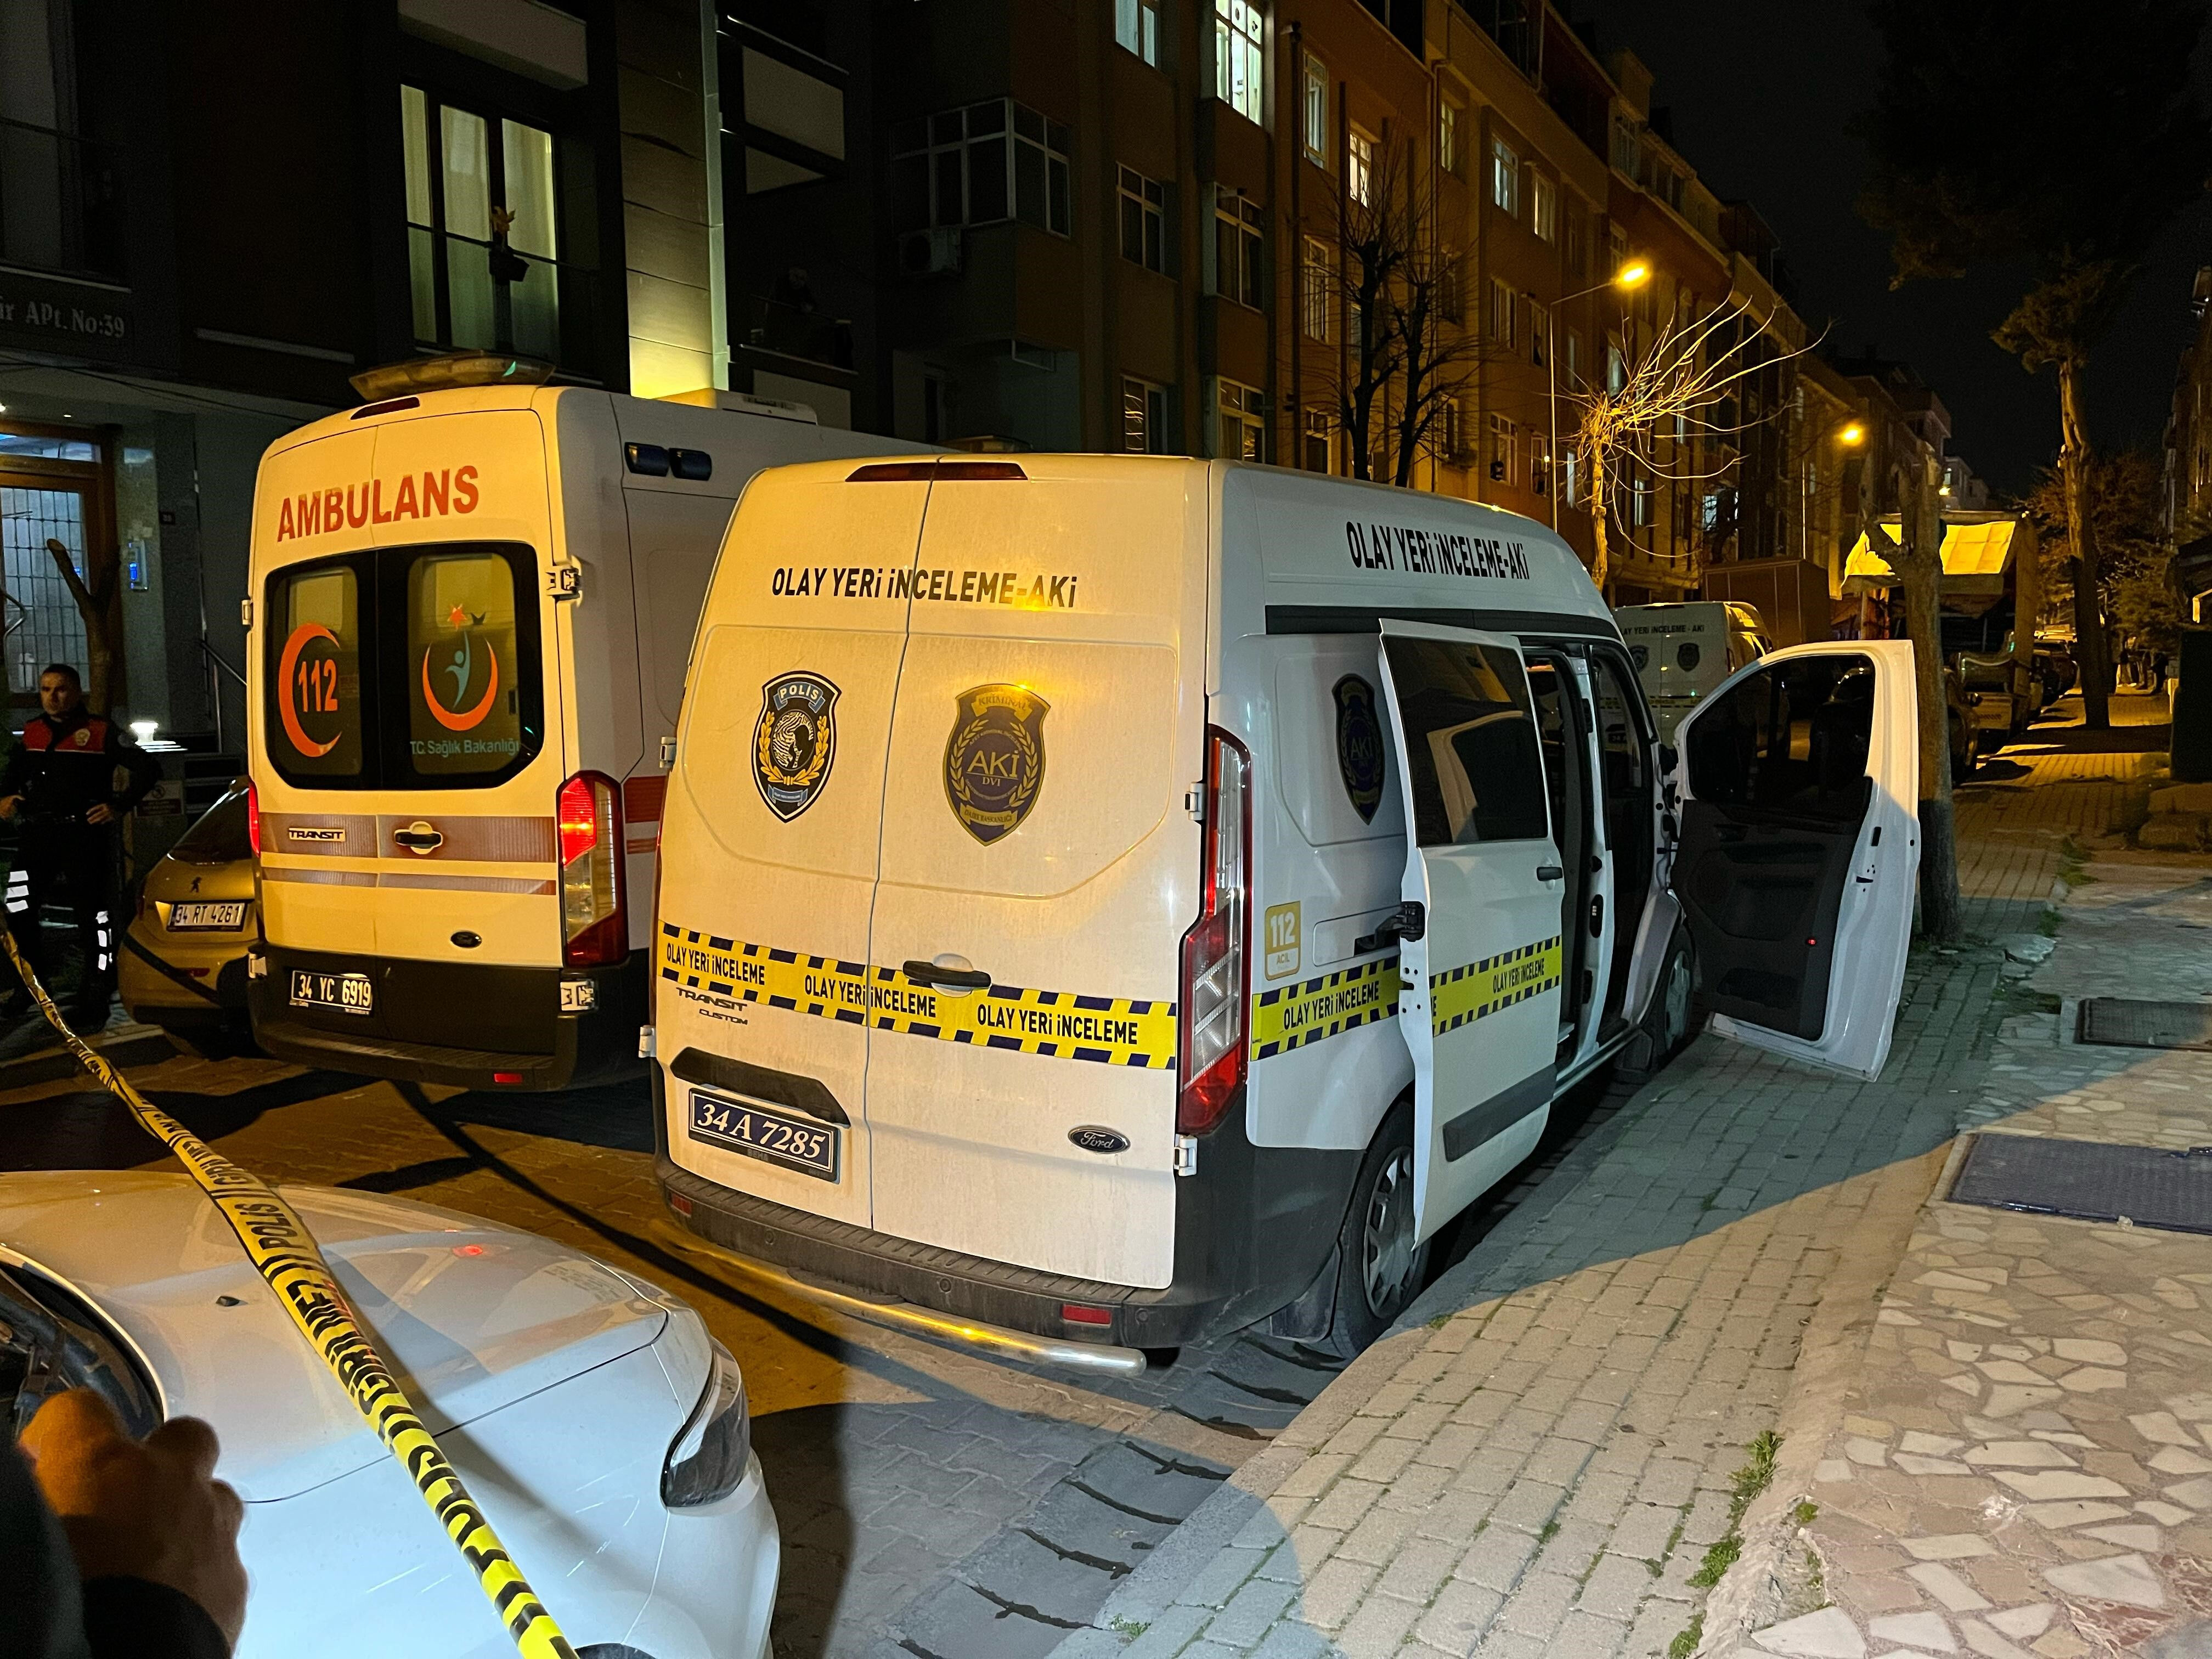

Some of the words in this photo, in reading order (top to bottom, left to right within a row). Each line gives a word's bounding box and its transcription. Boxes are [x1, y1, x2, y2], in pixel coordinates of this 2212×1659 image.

[277, 465, 479, 542] AMBULANS
[1346, 521, 1394, 571] OLAY
[772, 568, 827, 596] OLAY
[298, 659, 338, 712] 112
[289, 829, 344, 840] TRANSIT
[176, 906, 188, 923] 34
[193, 905, 208, 923] RT
[211, 905, 240, 923] 4261
[1270, 911, 1295, 947] 112
[667, 943, 687, 967] OLAY
[298, 974, 312, 998] 34
[320, 977, 335, 1001] YC
[342, 979, 371, 1007] 6919
[804, 974, 836, 1000] OLAY
[1492, 972, 1507, 994] OLAY
[676, 987, 748, 1012] TRANSIT
[699, 1008, 748, 1025] CUSTOM
[977, 1004, 1015, 1030] OLAY
[1284, 1003, 1310, 1031] OLAY
[697, 1104, 730, 1132] 34
[729, 1114, 753, 1141] A
[760, 1120, 826, 1159] 7285
[1080, 1131, 1115, 1149] Ford
